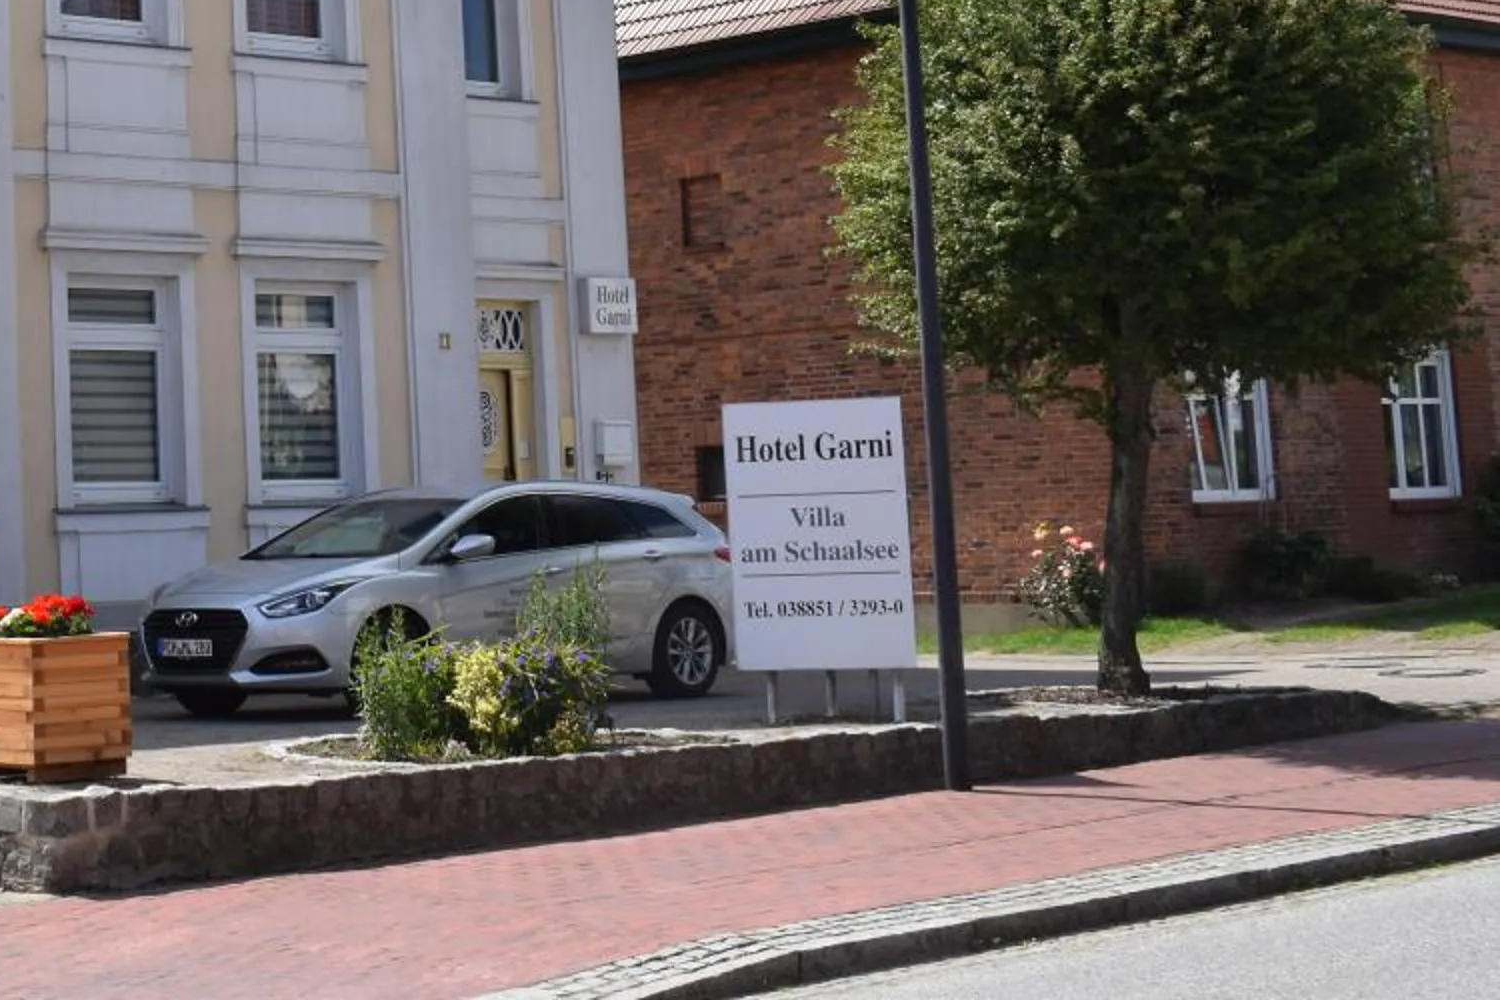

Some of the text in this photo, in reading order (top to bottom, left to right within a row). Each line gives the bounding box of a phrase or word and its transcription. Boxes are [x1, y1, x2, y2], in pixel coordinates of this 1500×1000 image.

[597, 286, 629, 304] Hotel
[596, 307, 631, 325] Garni
[736, 430, 894, 463] Hotel Garni
[790, 507, 846, 528] Villa
[741, 540, 900, 563] am Schaalsee
[744, 599, 903, 619] Tel. 038851 / 3293-0
